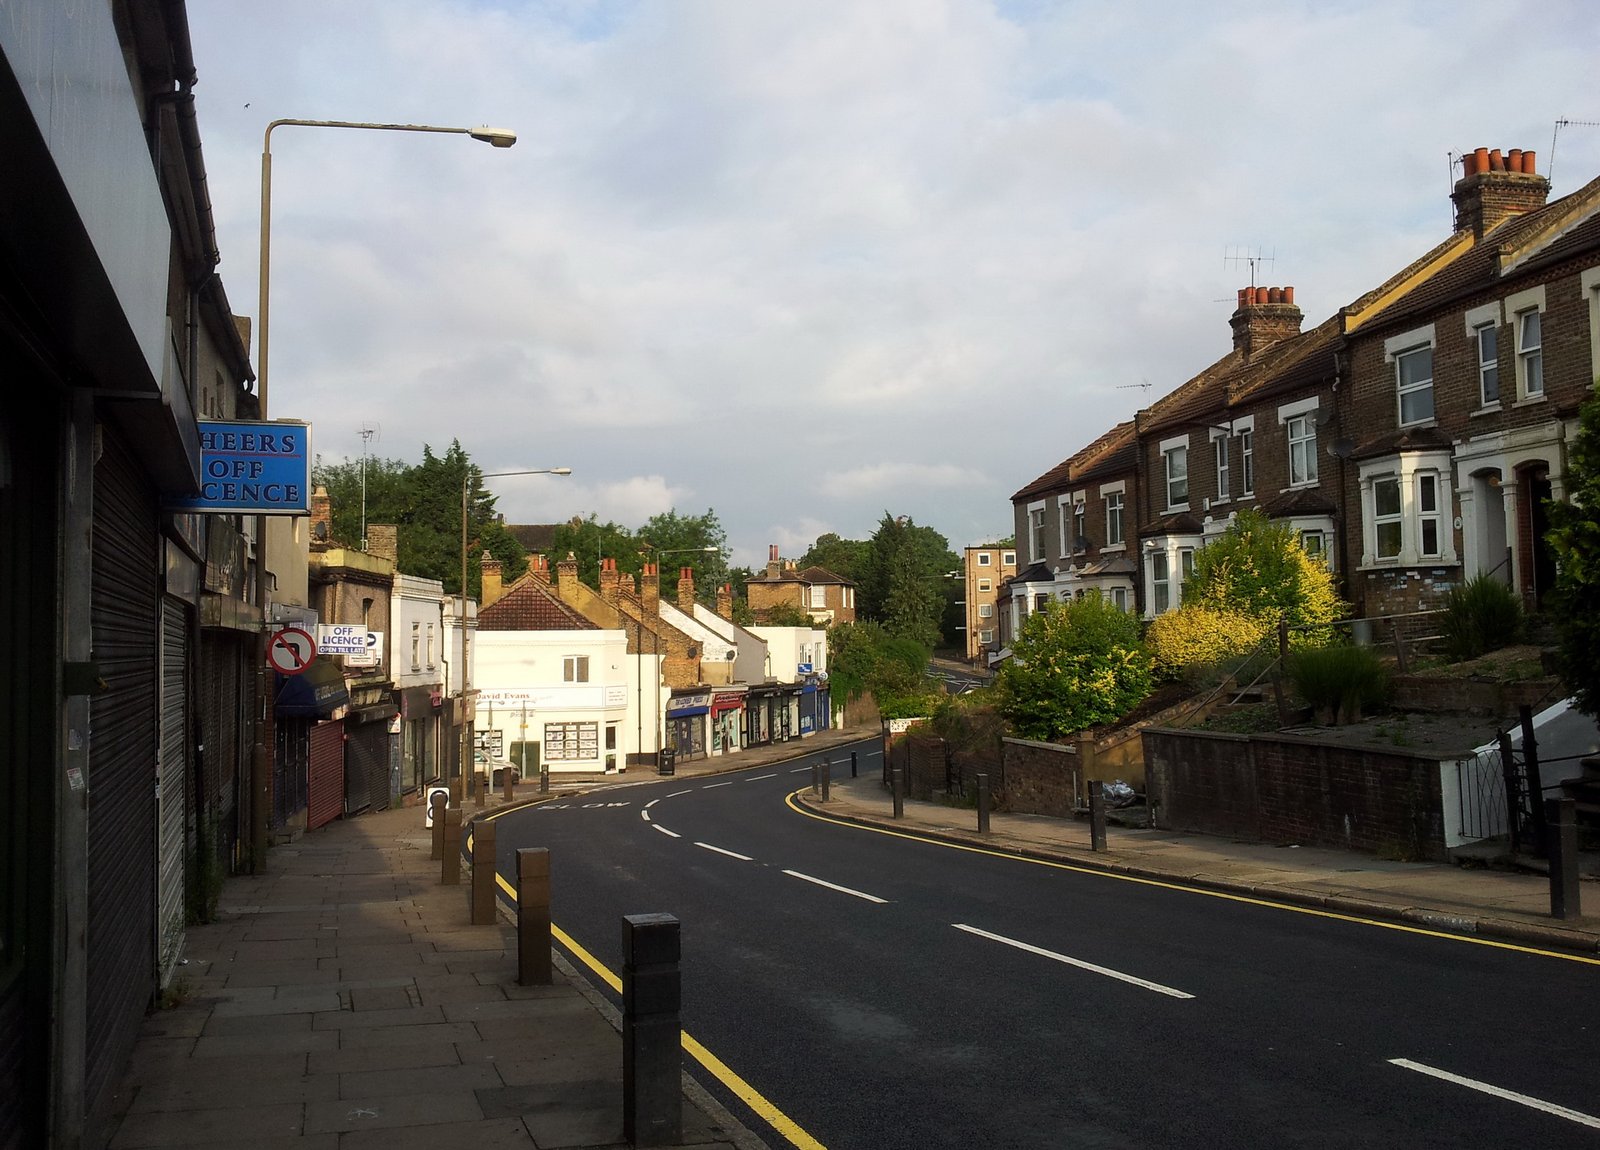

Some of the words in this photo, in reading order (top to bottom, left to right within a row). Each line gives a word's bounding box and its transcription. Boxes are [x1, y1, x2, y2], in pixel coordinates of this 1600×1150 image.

[201, 432, 295, 453] HEERS
[208, 459, 264, 479] OFF
[201, 482, 299, 503] CENCE
[334, 627, 353, 636] OFF
[322, 636, 363, 645] LICENCE
[475, 692, 500, 700] David
